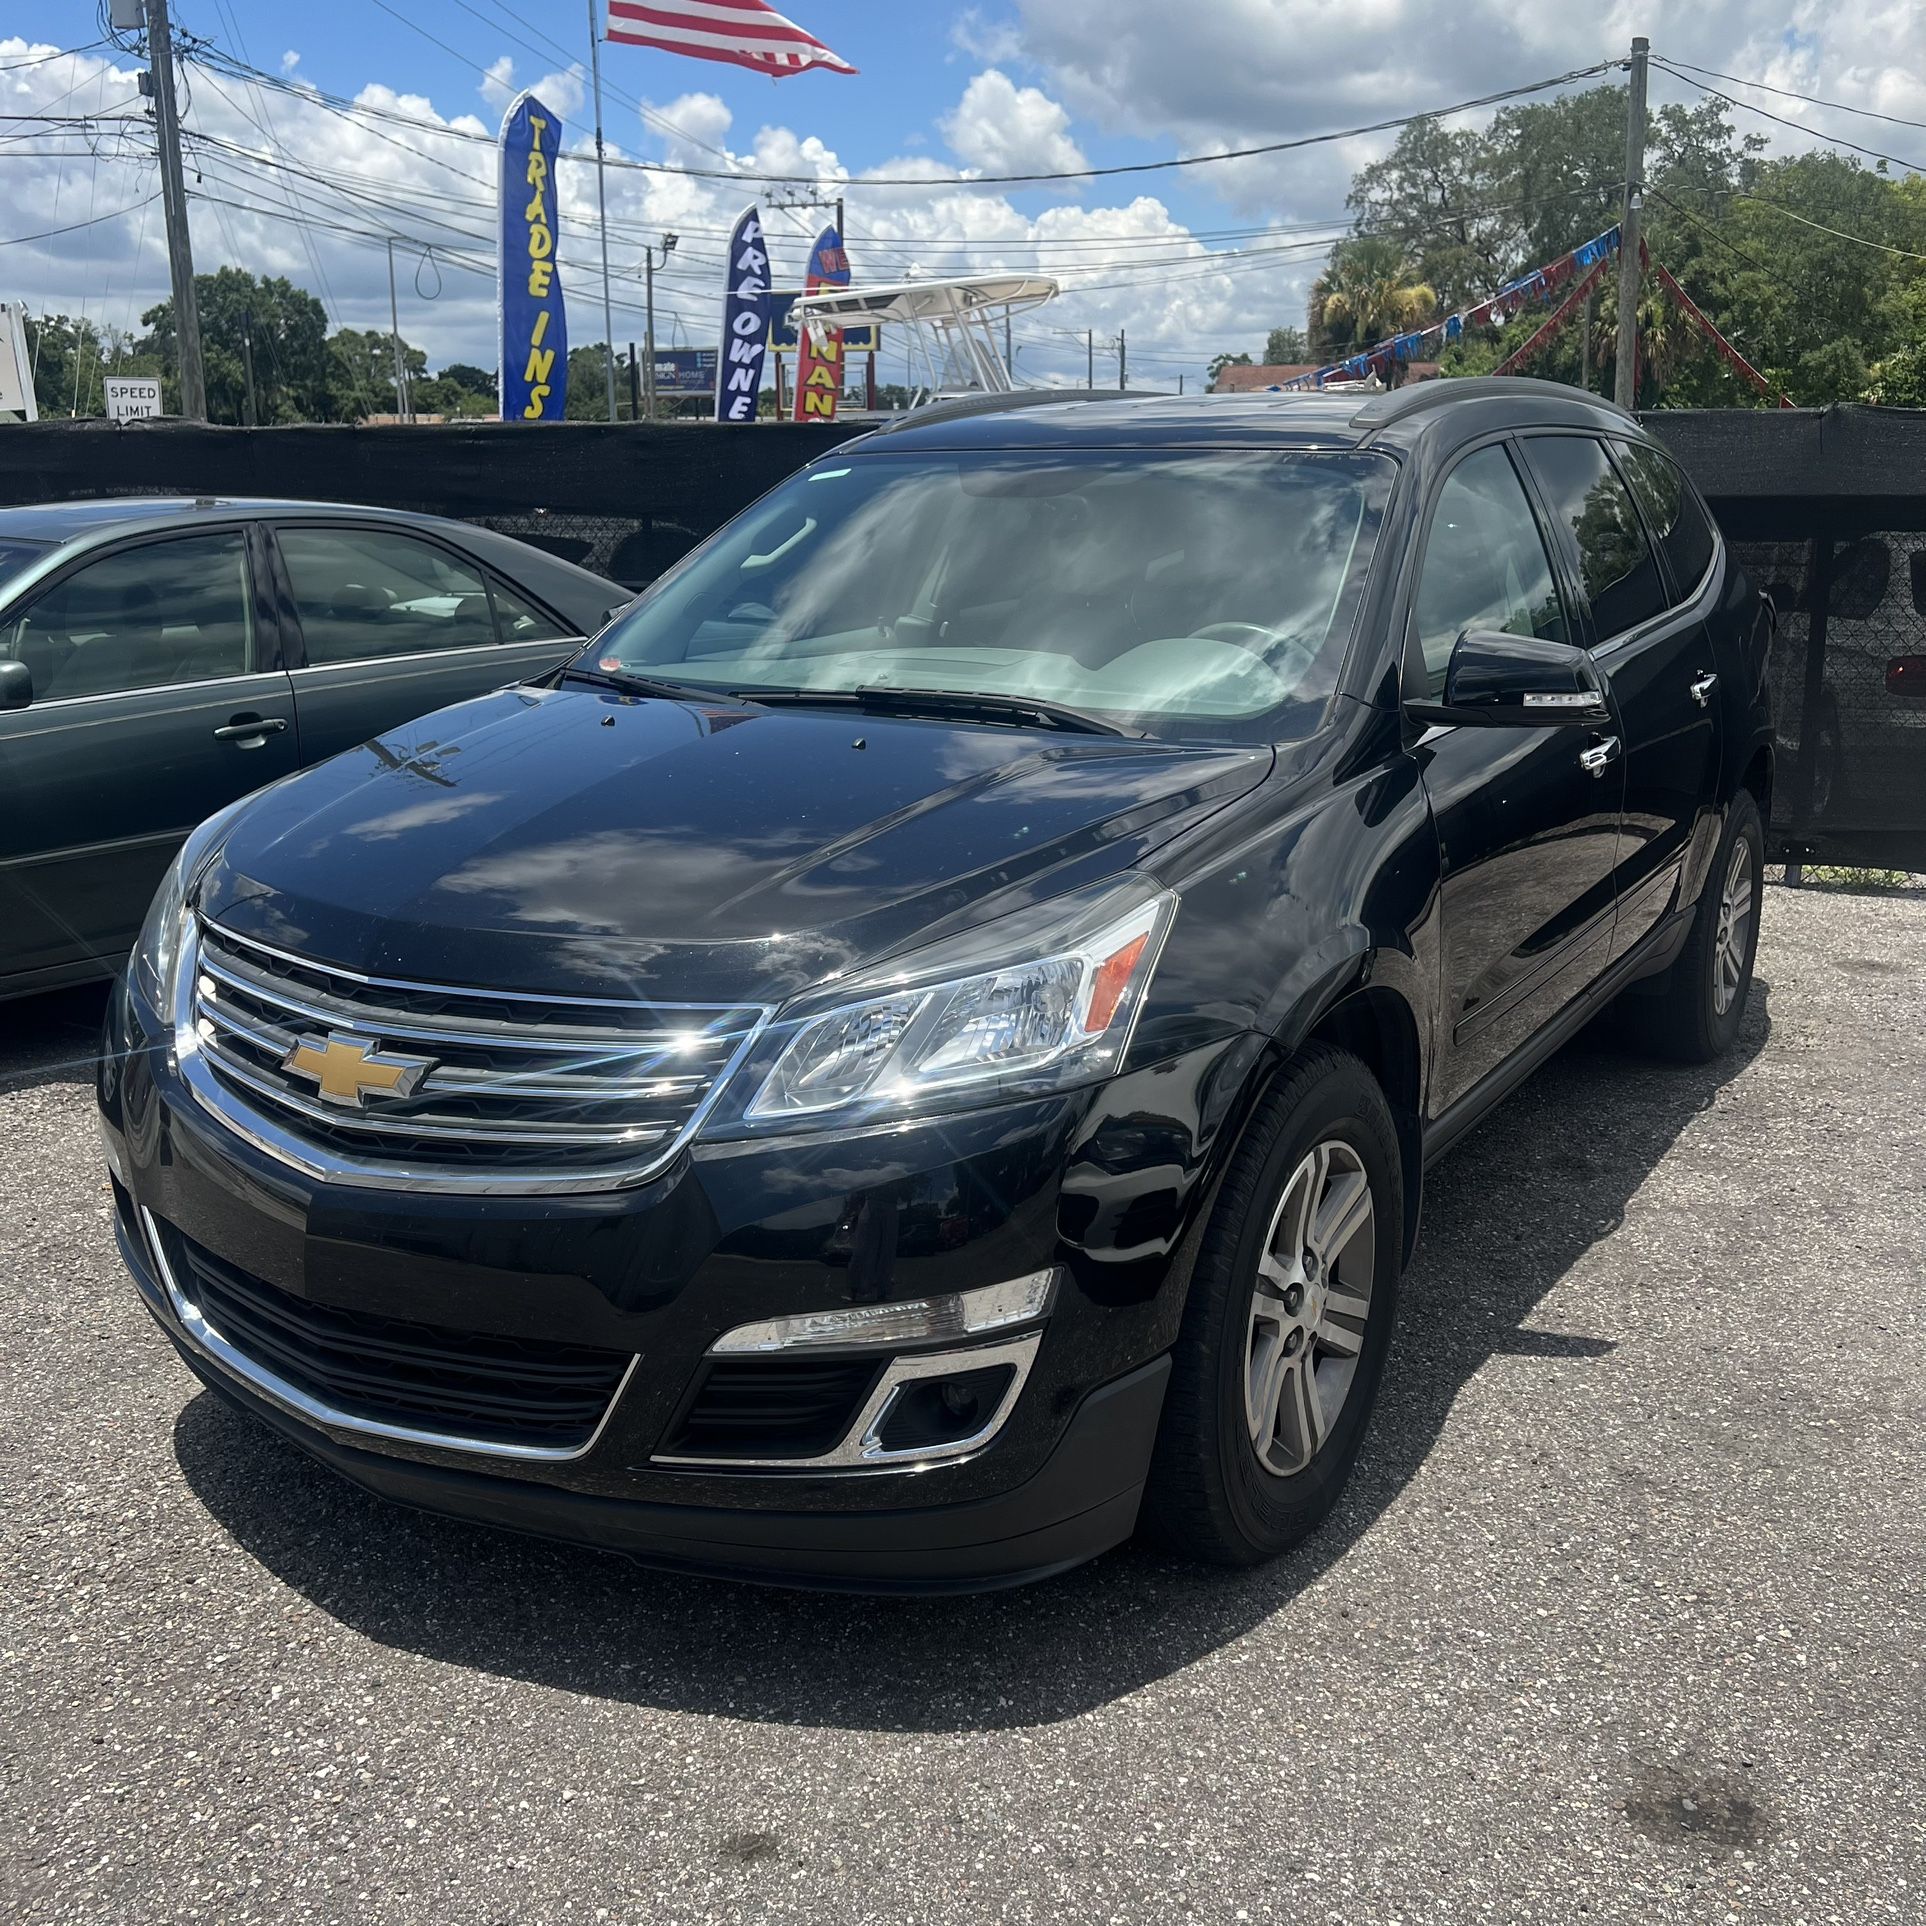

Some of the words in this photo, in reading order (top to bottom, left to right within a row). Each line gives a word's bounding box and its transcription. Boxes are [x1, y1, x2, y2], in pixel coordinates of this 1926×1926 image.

[525, 114, 554, 298] TRADE
[736, 220, 767, 301] PRE
[818, 246, 849, 274] WE
[523, 310, 555, 419] INS
[110, 386, 156, 399] SPEED
[116, 405, 152, 417] LIMIT
